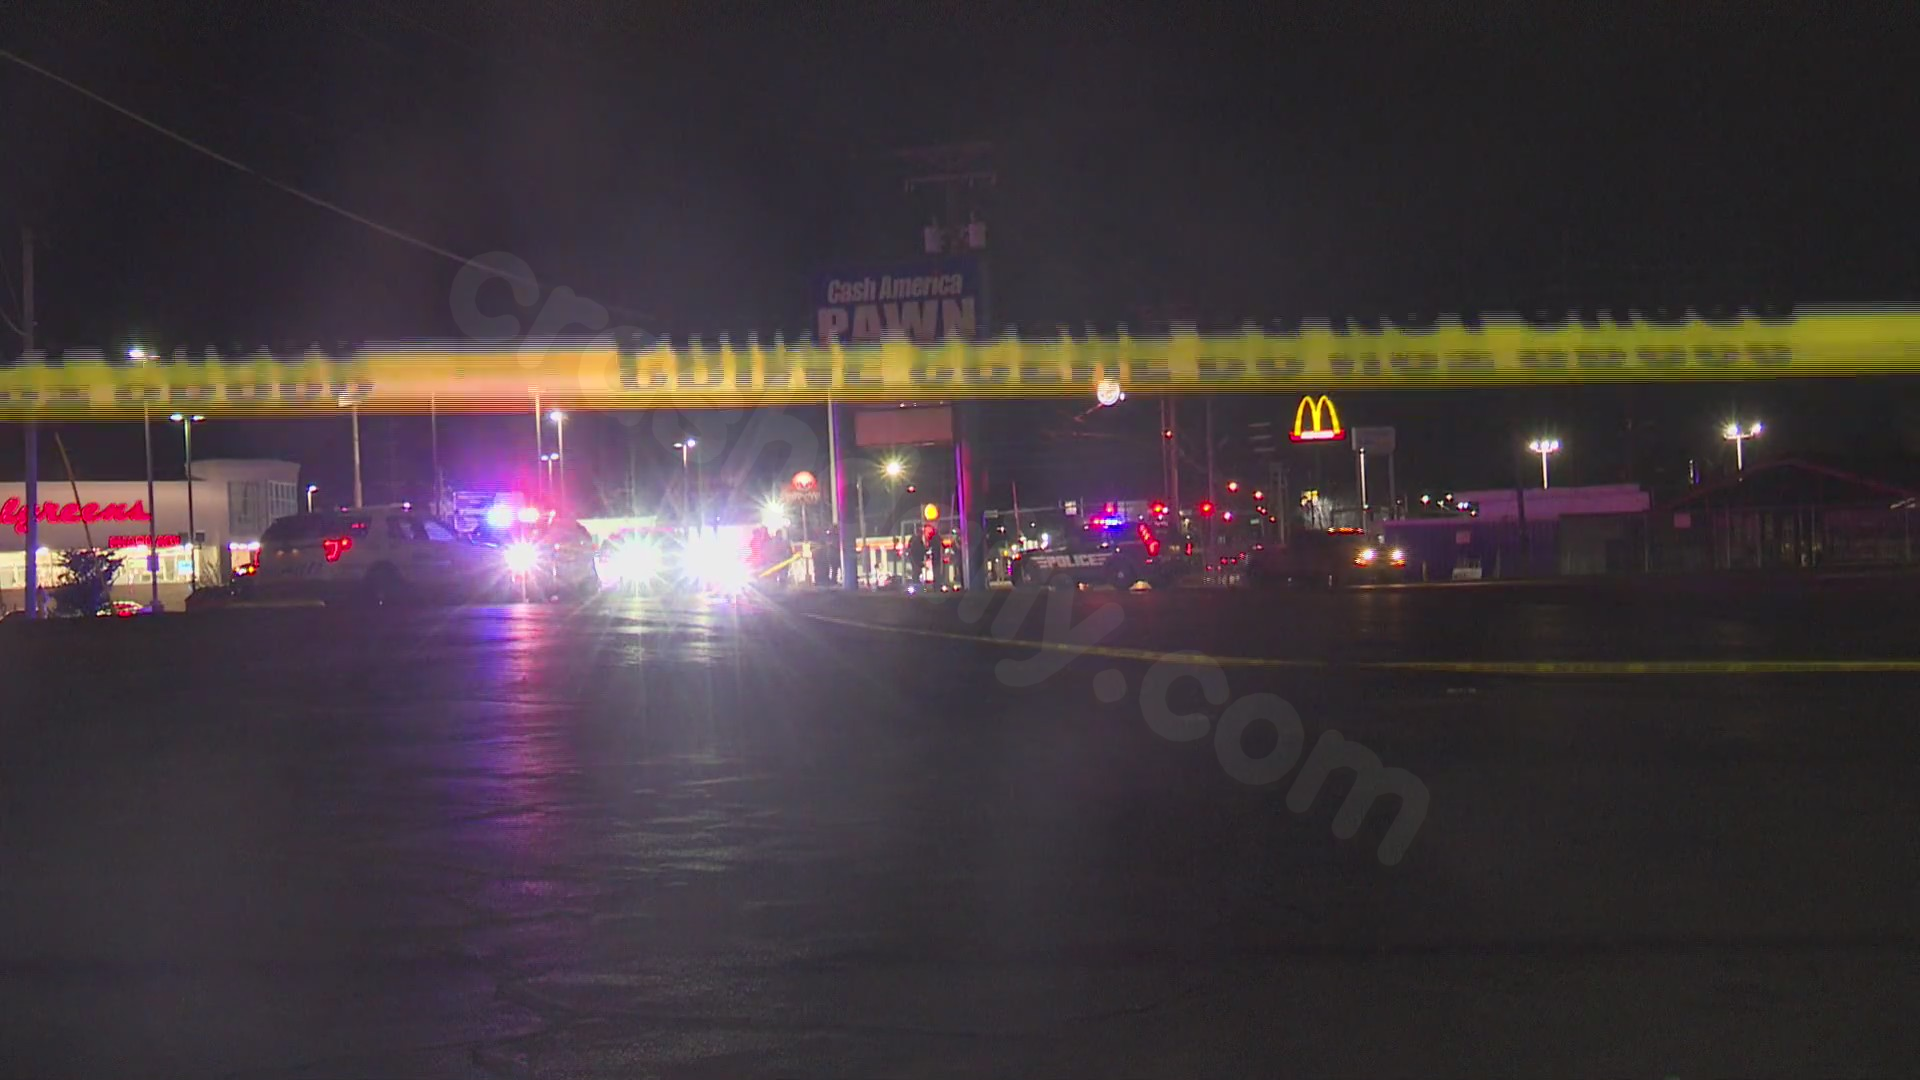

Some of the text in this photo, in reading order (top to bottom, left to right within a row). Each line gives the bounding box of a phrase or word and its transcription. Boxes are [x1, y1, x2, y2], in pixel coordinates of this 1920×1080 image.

[827, 272, 963, 304] Cash America
[819, 297, 976, 343] PAWN
[0, 496, 152, 535] lgreens
[1046, 554, 1100, 568] POLICE
